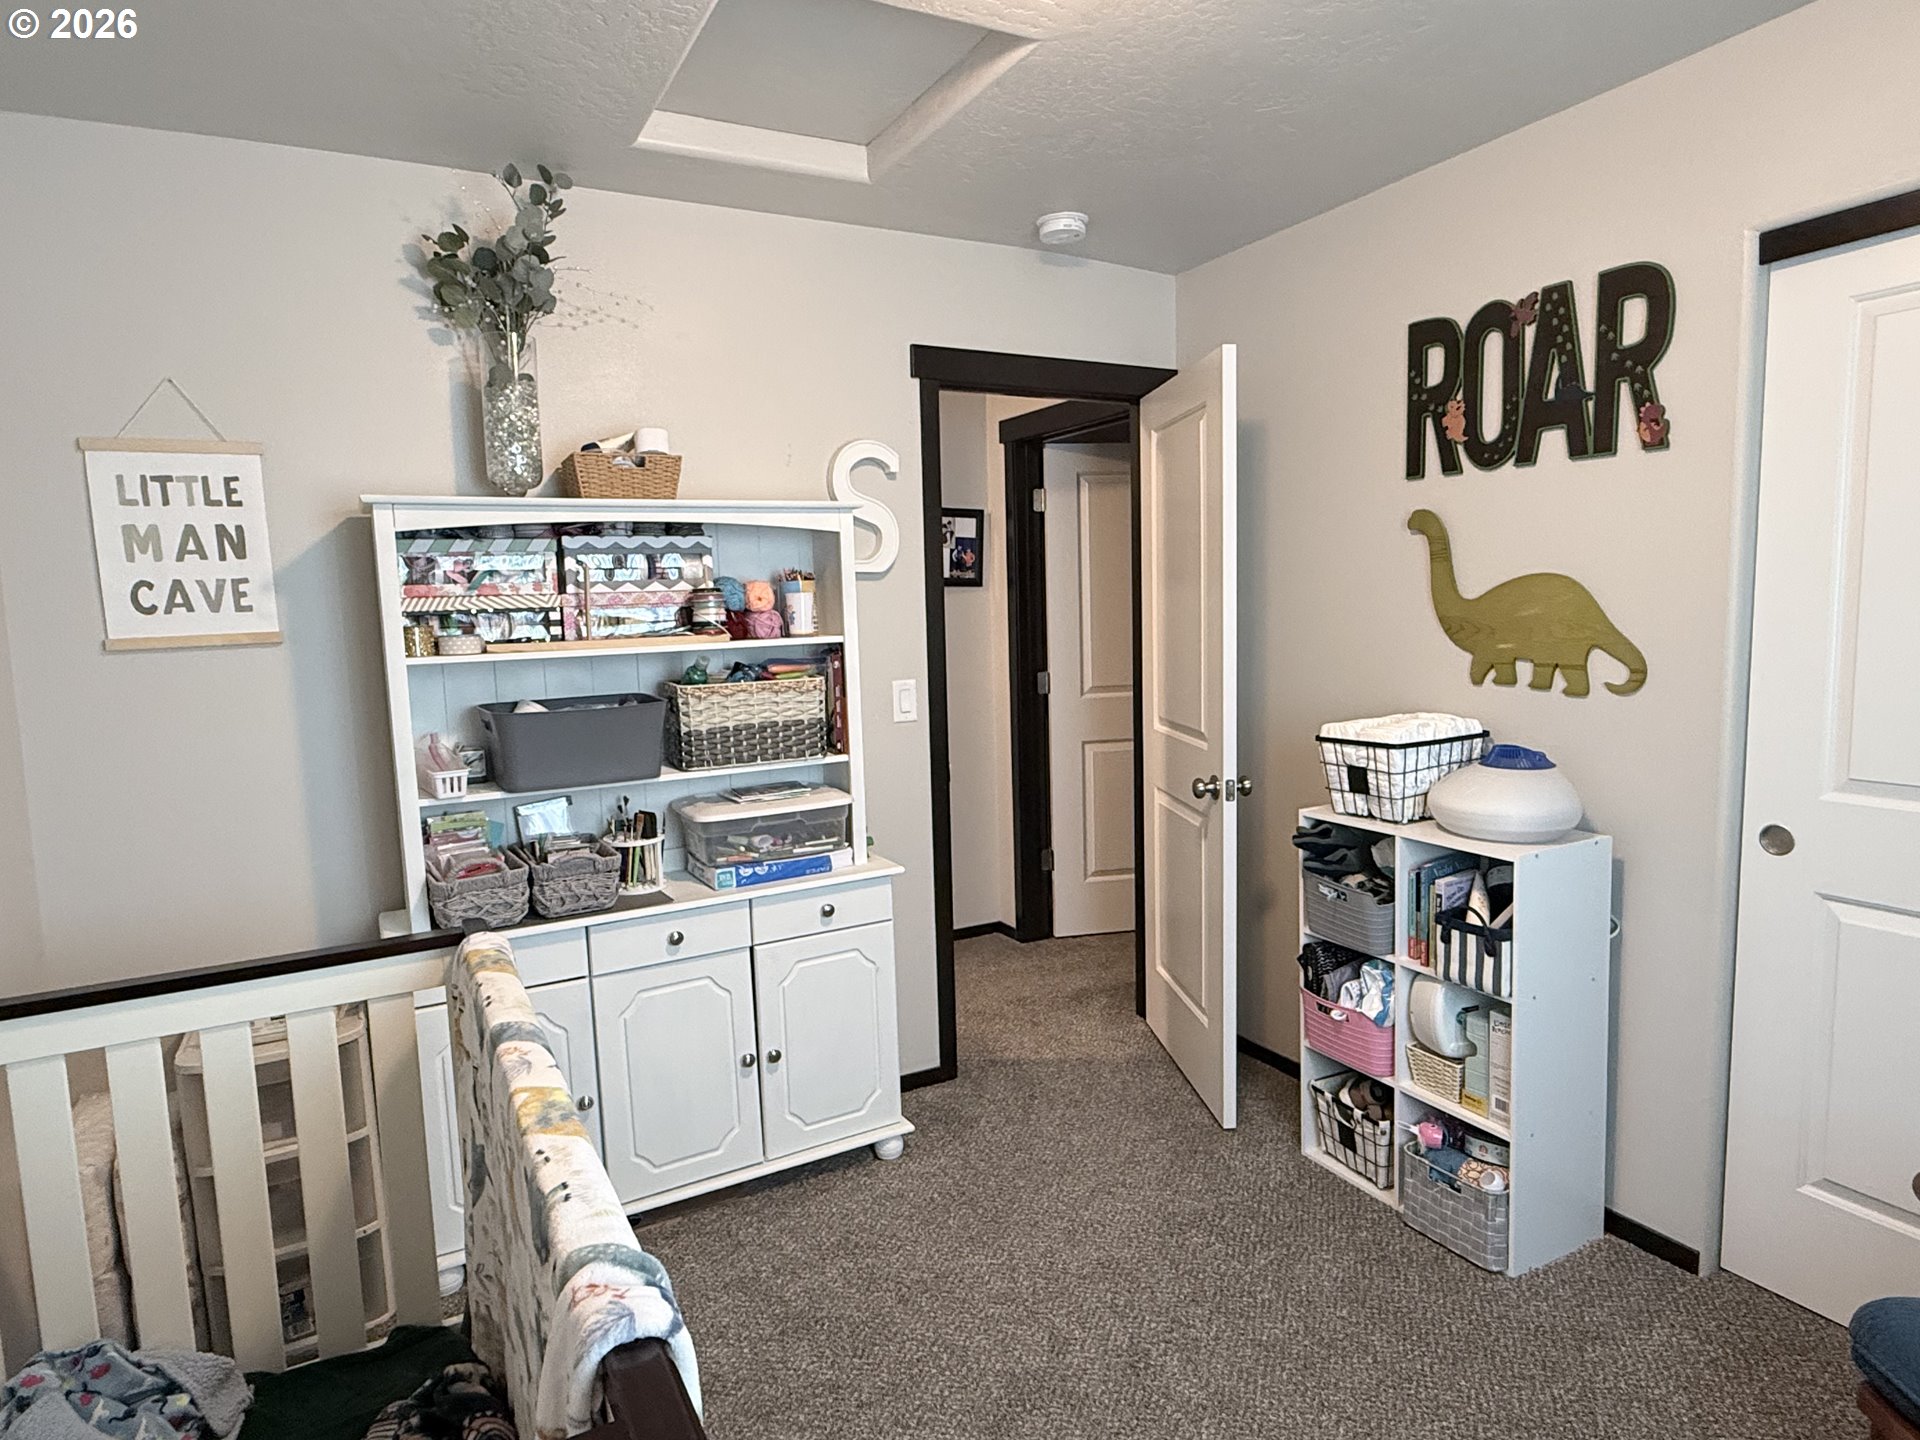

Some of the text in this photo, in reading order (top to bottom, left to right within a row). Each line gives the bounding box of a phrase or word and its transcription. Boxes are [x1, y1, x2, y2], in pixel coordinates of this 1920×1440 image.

[1405, 261, 1676, 482] ROAR
[115, 474, 243, 507] LITTLE
[832, 440, 899, 572] S
[121, 523, 247, 563] MAN
[130, 578, 254, 615] CAVE
